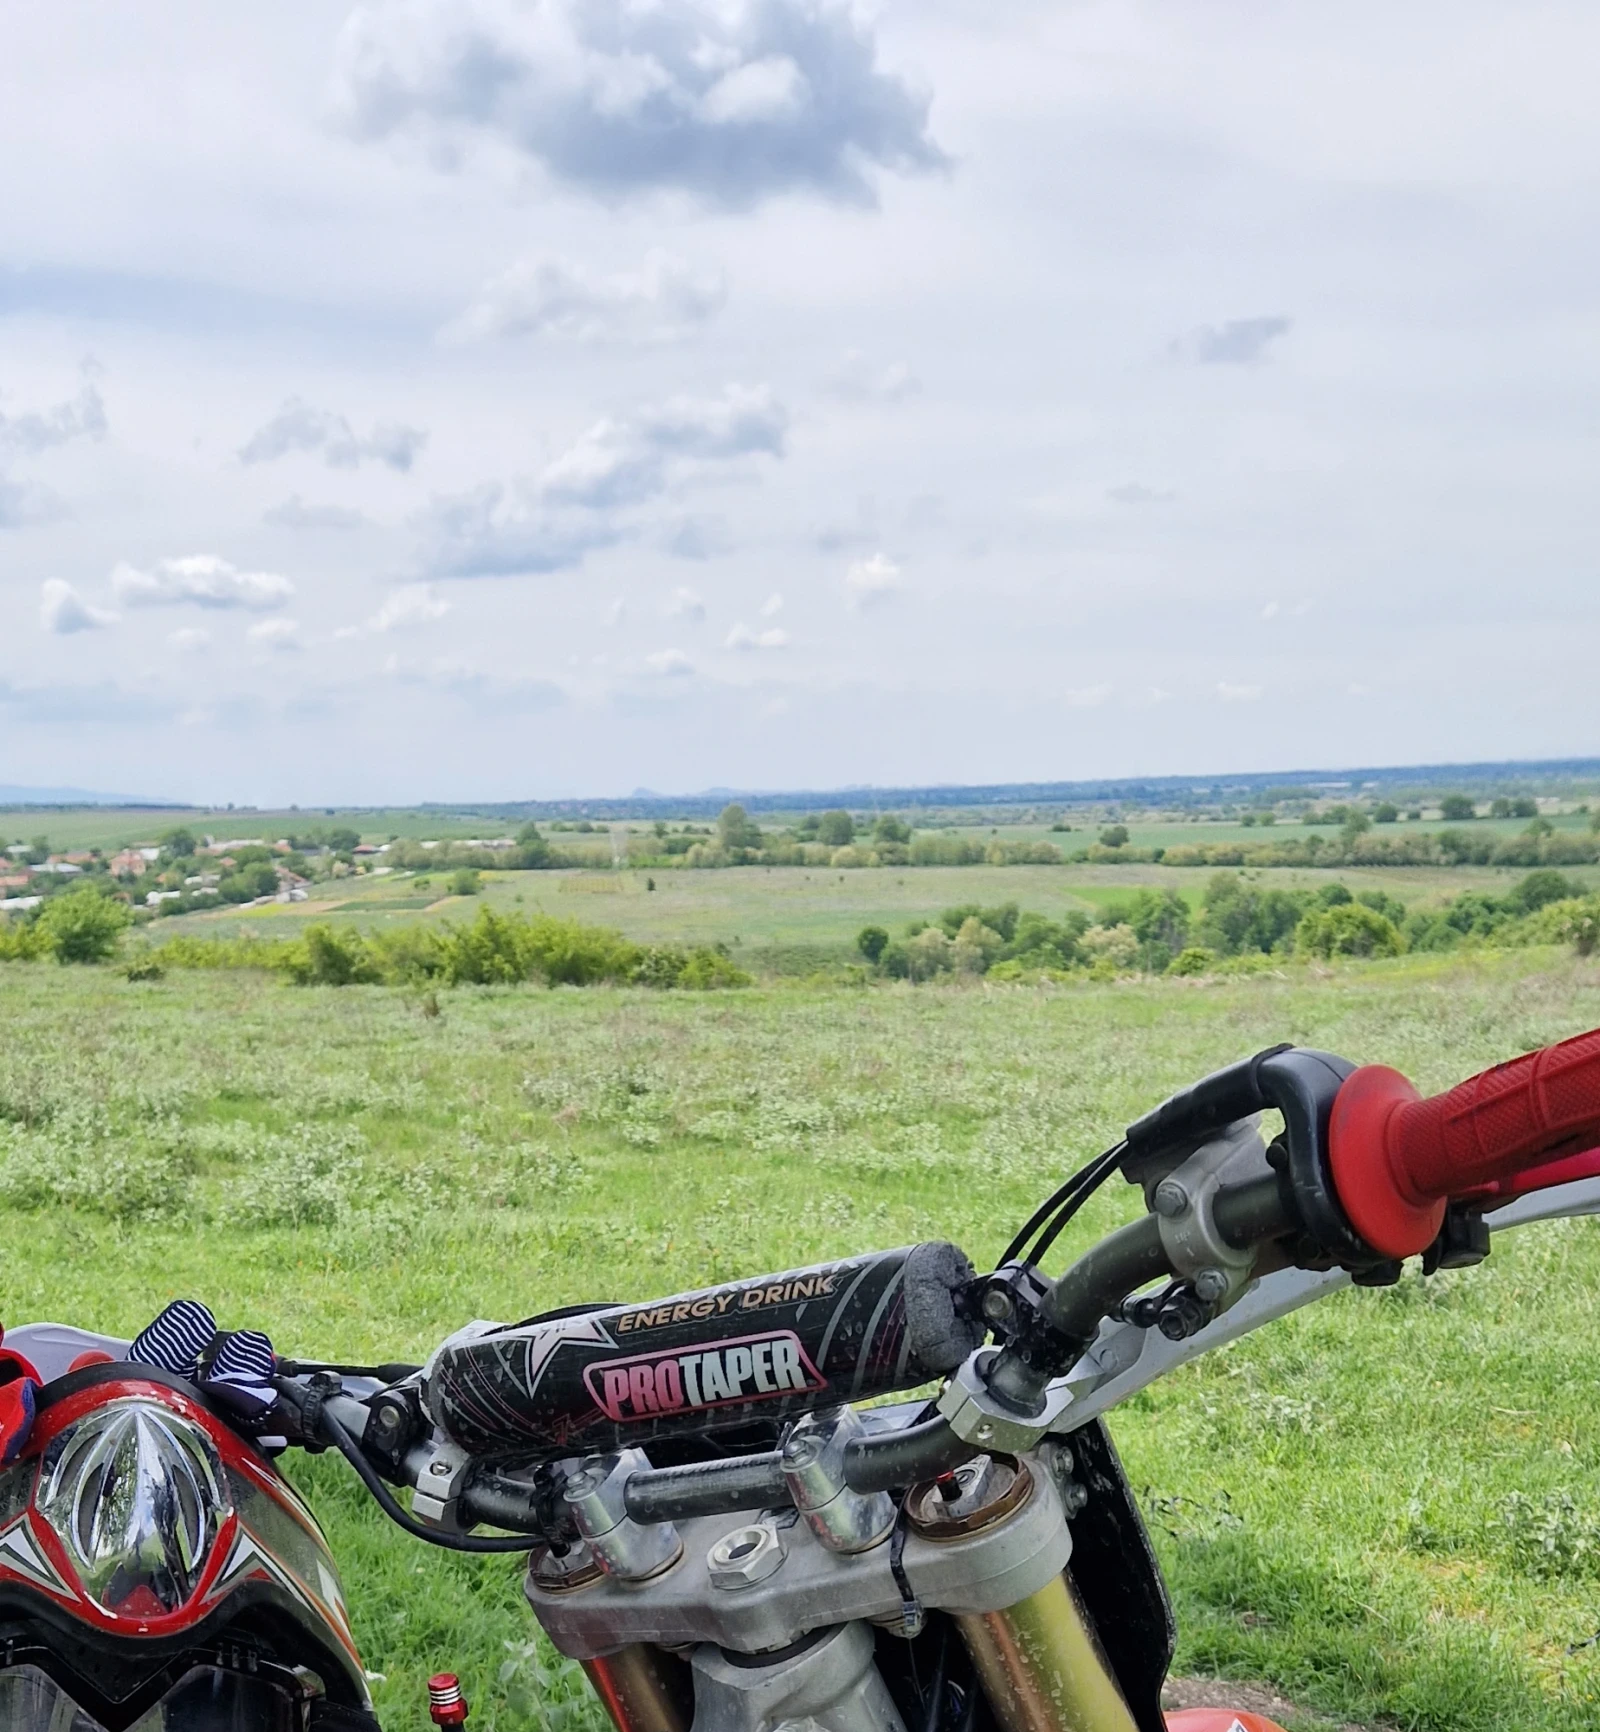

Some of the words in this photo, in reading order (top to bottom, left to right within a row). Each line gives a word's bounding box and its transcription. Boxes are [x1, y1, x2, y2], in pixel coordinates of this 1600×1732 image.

[617, 1293, 736, 1332] ENERGY
[741, 1275, 835, 1308] DRINK
[603, 1338, 807, 1419] PROTAPER
